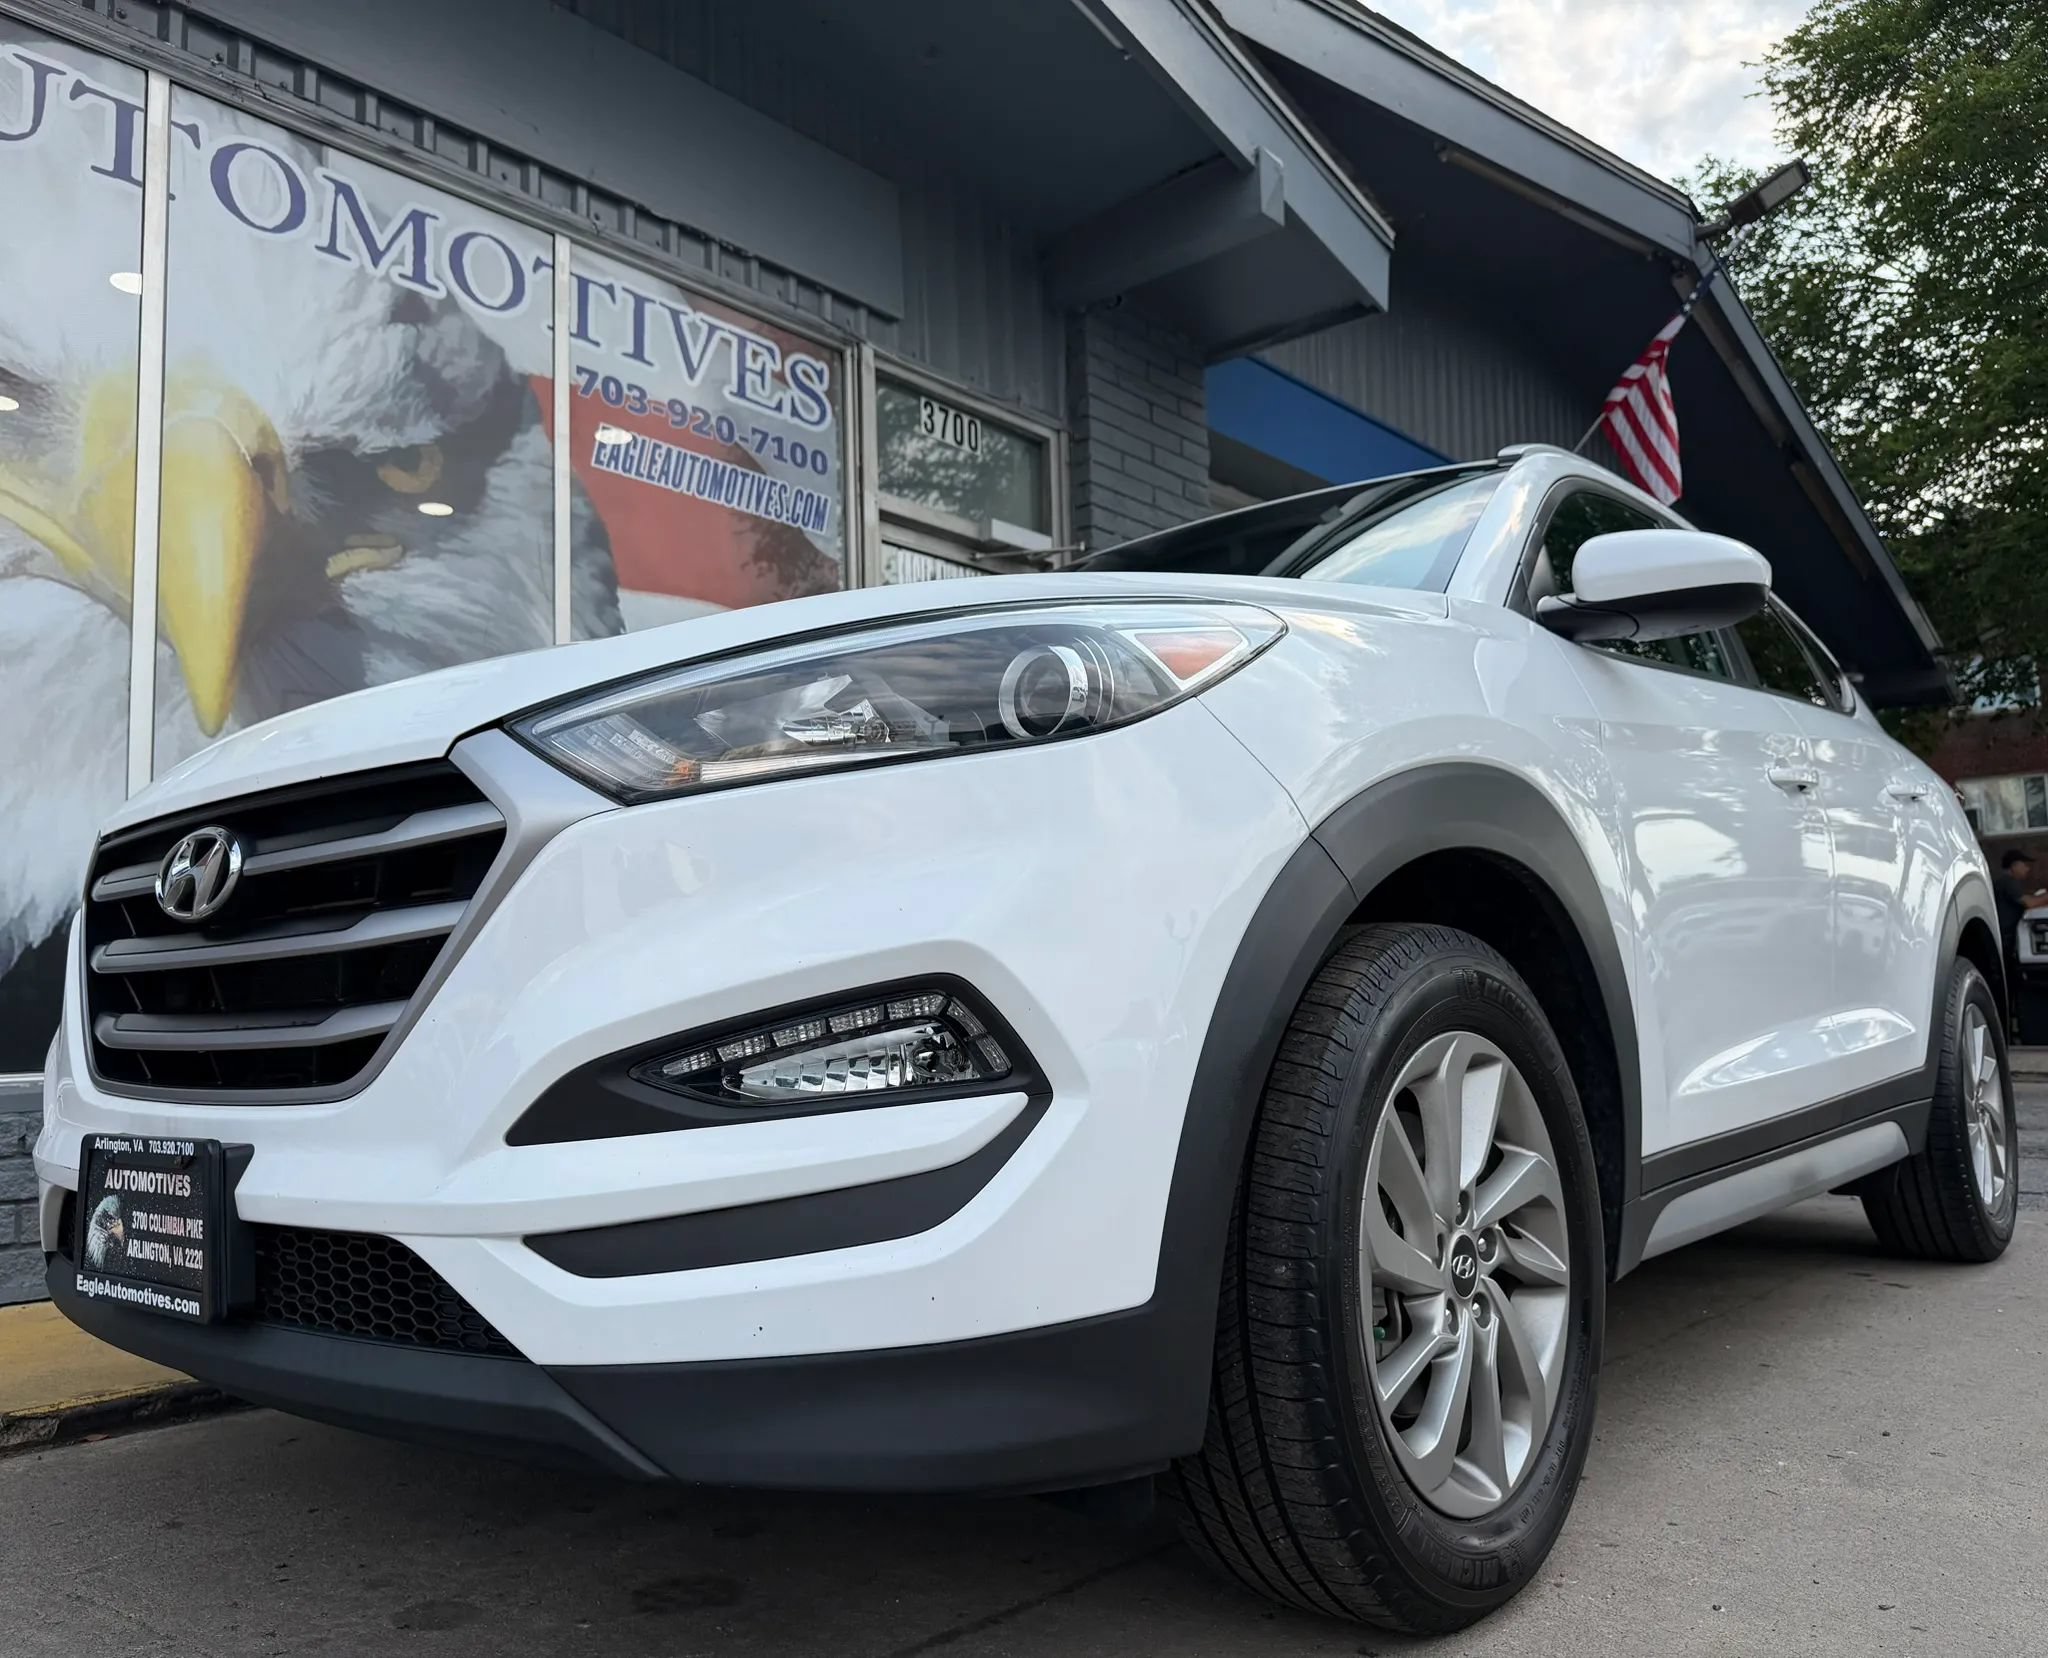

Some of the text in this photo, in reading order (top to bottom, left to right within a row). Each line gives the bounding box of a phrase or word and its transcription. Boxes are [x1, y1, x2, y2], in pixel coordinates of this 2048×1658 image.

[576, 365, 829, 476] 703-920-7100
[924, 401, 978, 452] 3700
[593, 425, 830, 533] EAGLEAUTOMOTIVES.COM
[95, 1137, 195, 1156] Arlington, VA 703.920.7100
[104, 1168, 191, 1198] AUTOMOTIVES
[132, 1211, 203, 1240] 3700 COLUMBIA PIKE
[127, 1238, 172, 1268] ARLINGTON,
[173, 1245, 184, 1266] VA
[76, 1274, 200, 1316] EagleAutomotives.com
